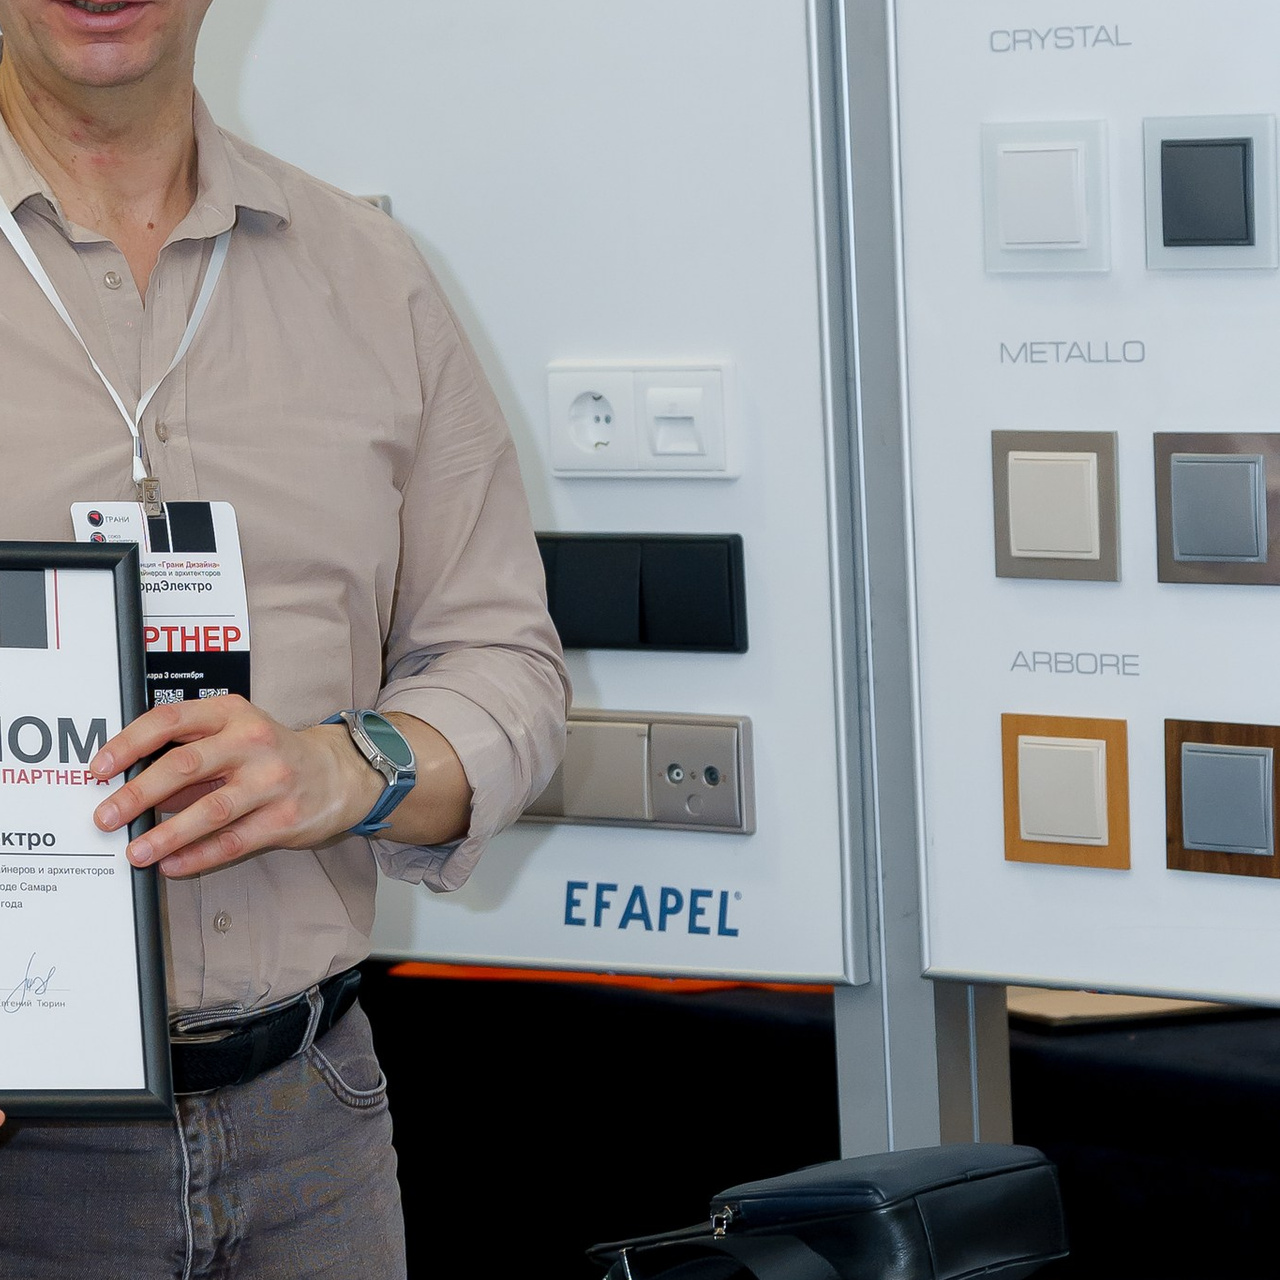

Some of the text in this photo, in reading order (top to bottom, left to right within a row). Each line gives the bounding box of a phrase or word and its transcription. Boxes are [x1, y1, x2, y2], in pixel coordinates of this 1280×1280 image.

[989, 24, 1133, 54] CRYSTAL
[999, 339, 1146, 365] METALLO
[140, 580, 213, 594] ордЭлектро
[143, 626, 242, 652] РТНЕР
[1010, 651, 1140, 676] ARBORE
[170, 671, 204, 680] сентября
[38, 866, 45, 874] и
[47, 867, 115, 877] архитекторов
[19, 882, 58, 893] Самара
[0, 901, 23, 910] года
[37, 999, 66, 1009] Тюрин
